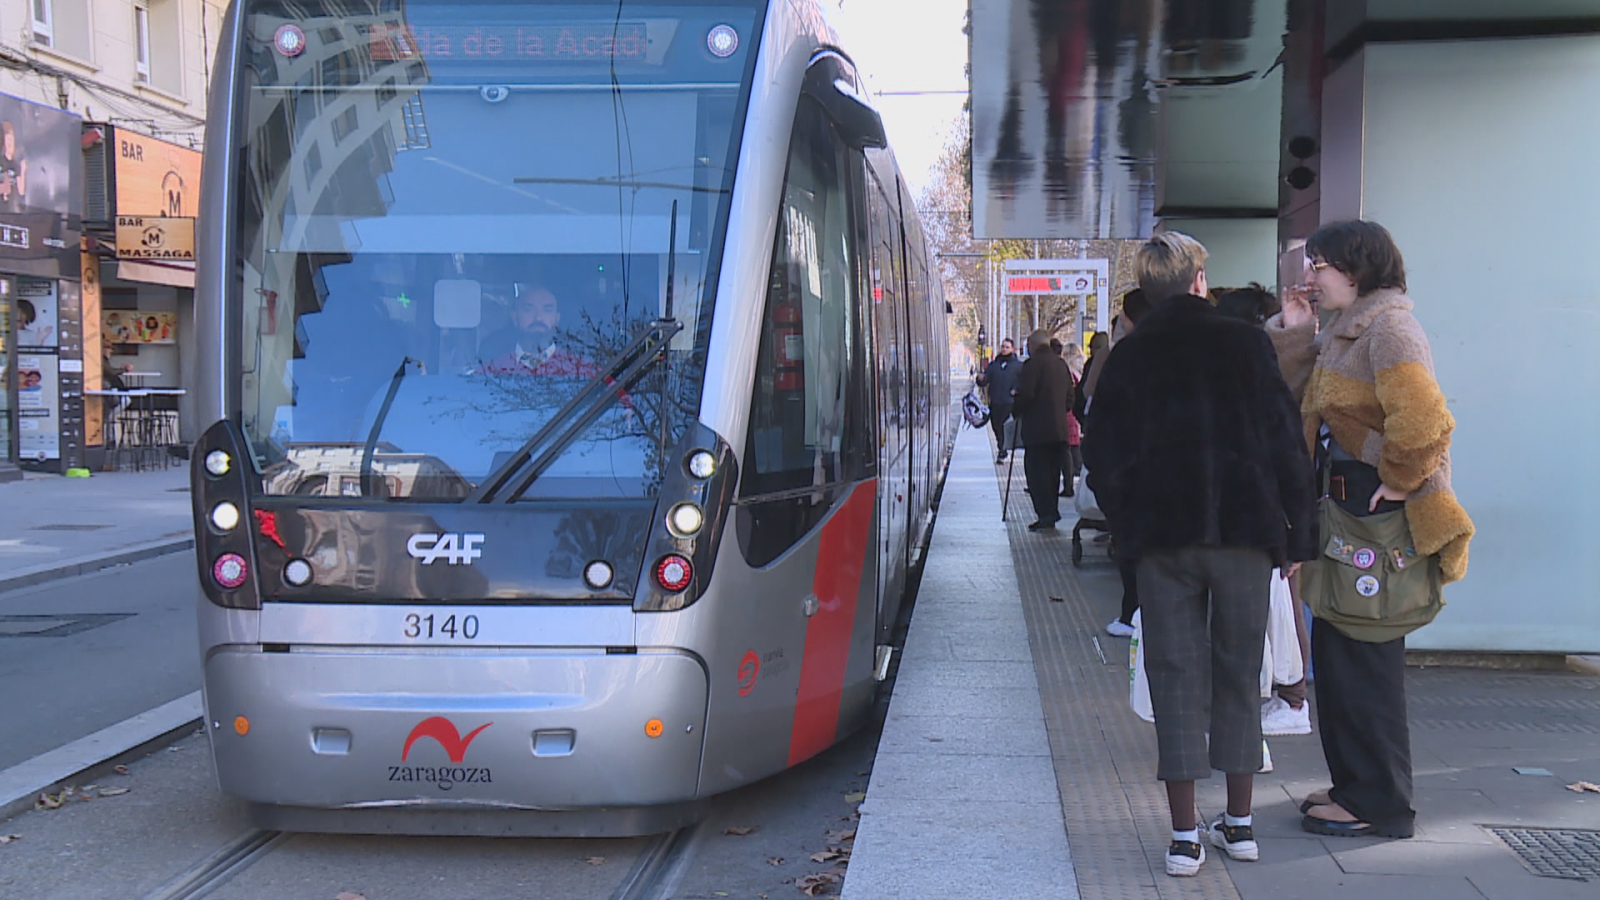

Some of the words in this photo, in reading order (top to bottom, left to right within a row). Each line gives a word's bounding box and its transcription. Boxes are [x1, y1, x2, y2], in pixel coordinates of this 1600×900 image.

[463, 28, 504, 56] de
[518, 28, 544, 56] la
[121, 140, 144, 162] BAR
[168, 190, 181, 218] M
[119, 217, 143, 227] BAR
[148, 233, 160, 244] M
[119, 249, 193, 258] MASSAGA
[407, 533, 485, 565] CAF
[404, 612, 480, 640] 3140
[388, 765, 492, 790] zaragoza
